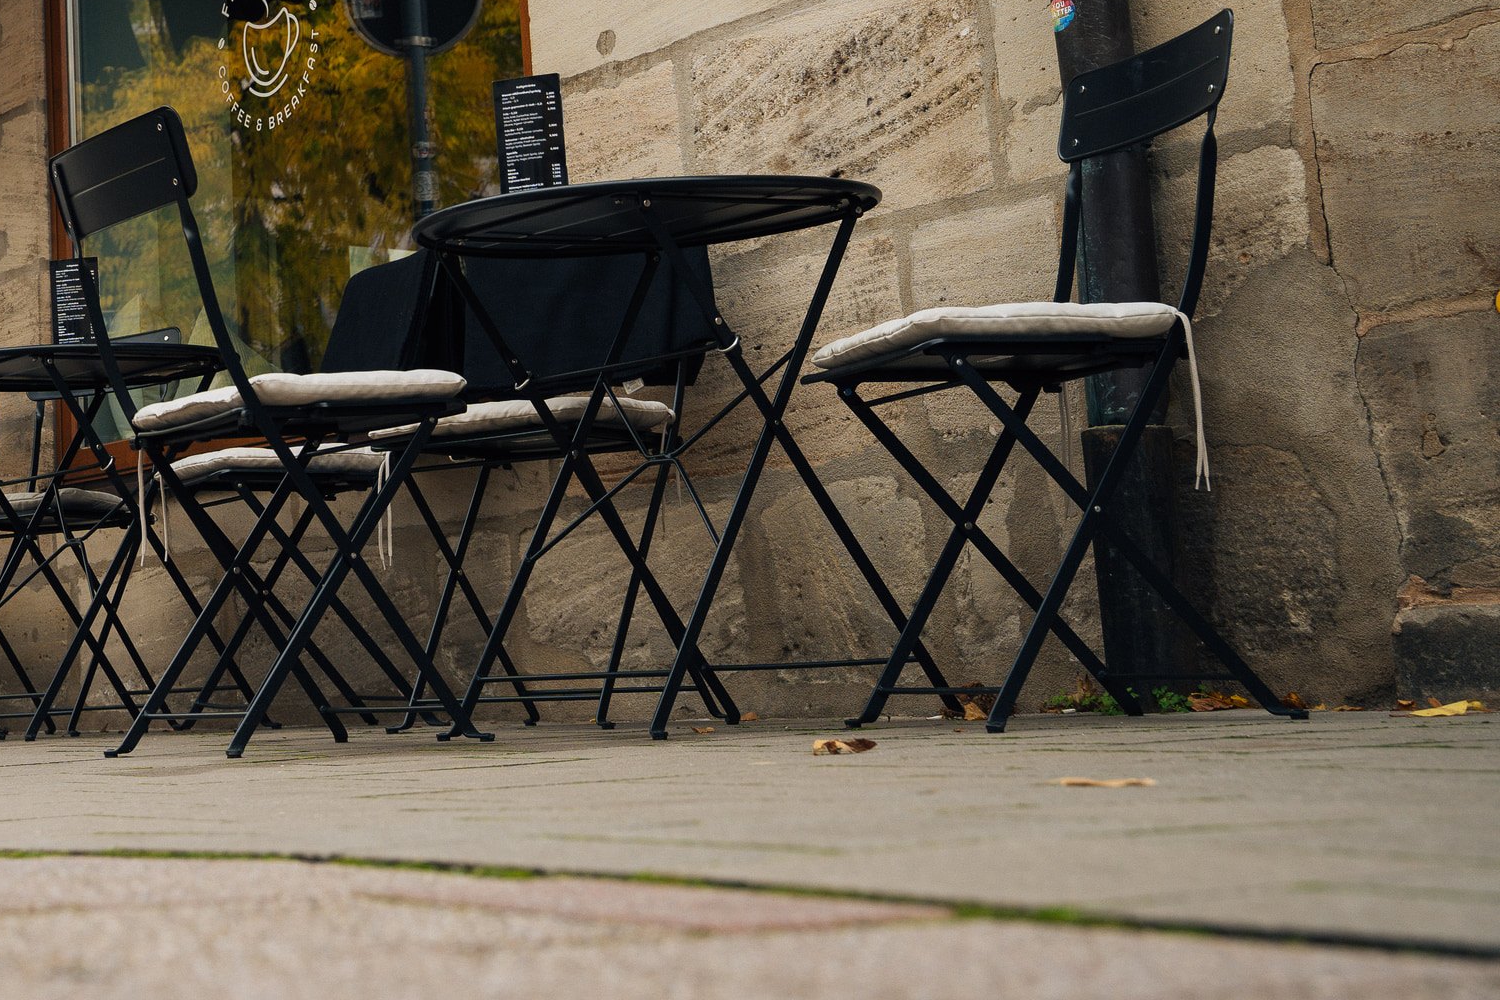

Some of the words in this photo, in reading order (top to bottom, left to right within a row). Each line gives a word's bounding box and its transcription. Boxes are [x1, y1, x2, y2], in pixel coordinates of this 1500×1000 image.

[218, 65, 251, 129] COFFEE
[255, 118, 263, 132] &
[268, 28, 320, 130] BREAKFAST
